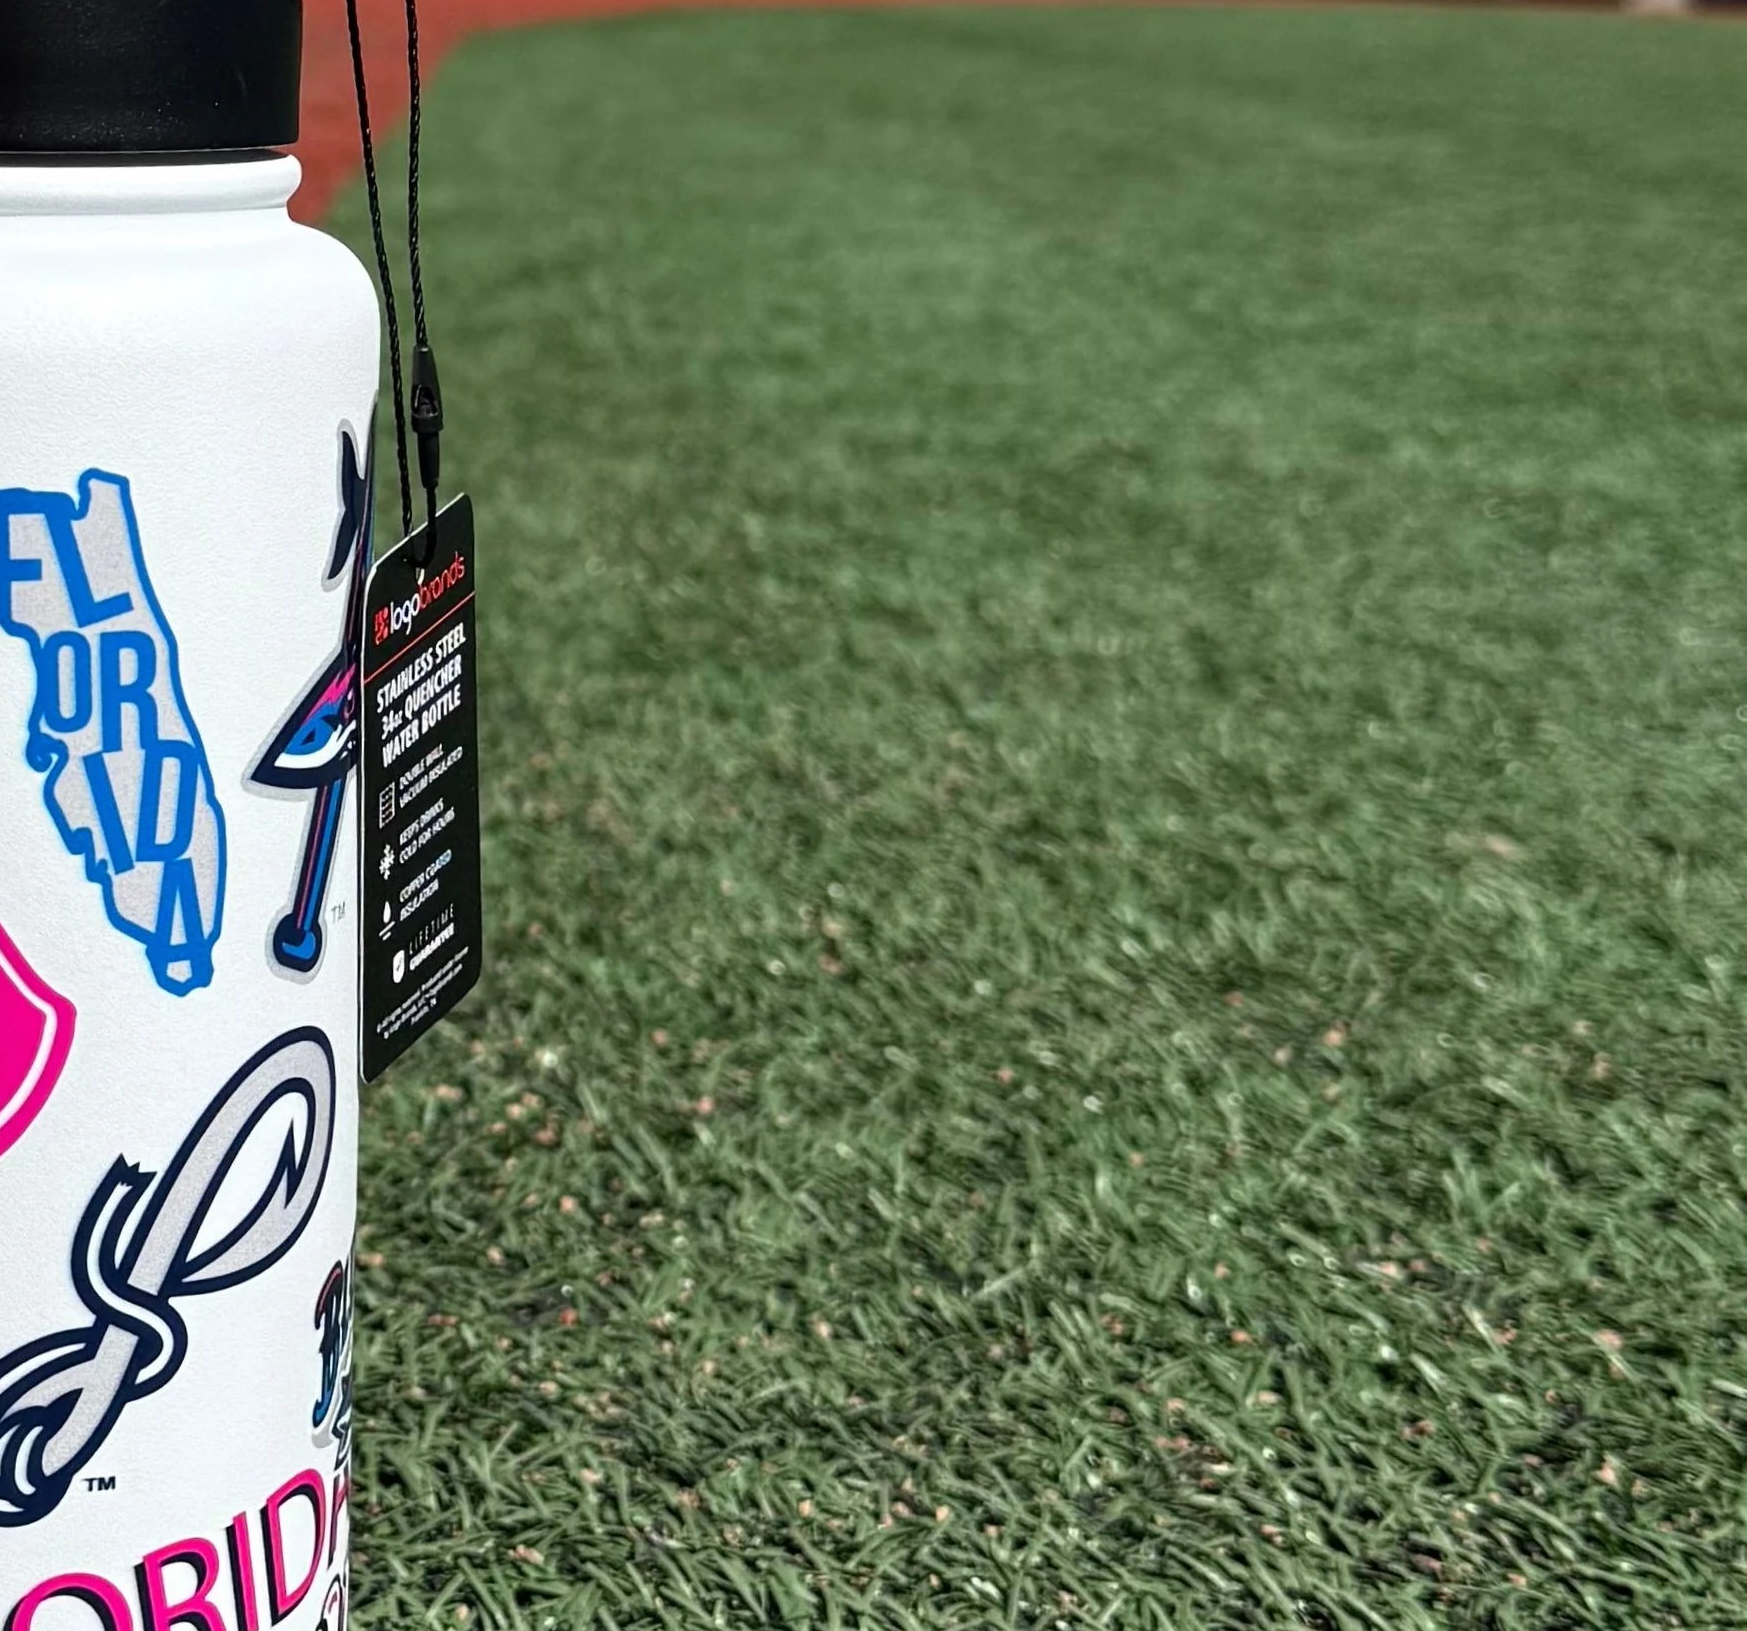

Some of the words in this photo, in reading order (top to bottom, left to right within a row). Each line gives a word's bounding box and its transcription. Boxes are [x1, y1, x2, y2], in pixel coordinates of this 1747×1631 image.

[389, 551, 465, 635] logobrands
[376, 644, 433, 713] STAINLESS
[435, 623, 466, 663] STEEL
[404, 654, 462, 717] QUENCHER
[382, 719, 419, 768] WATER
[422, 686, 461, 732] BOTTLE
[409, 903, 454, 955] LIFETIME
[82, 1475, 116, 1492] TM
